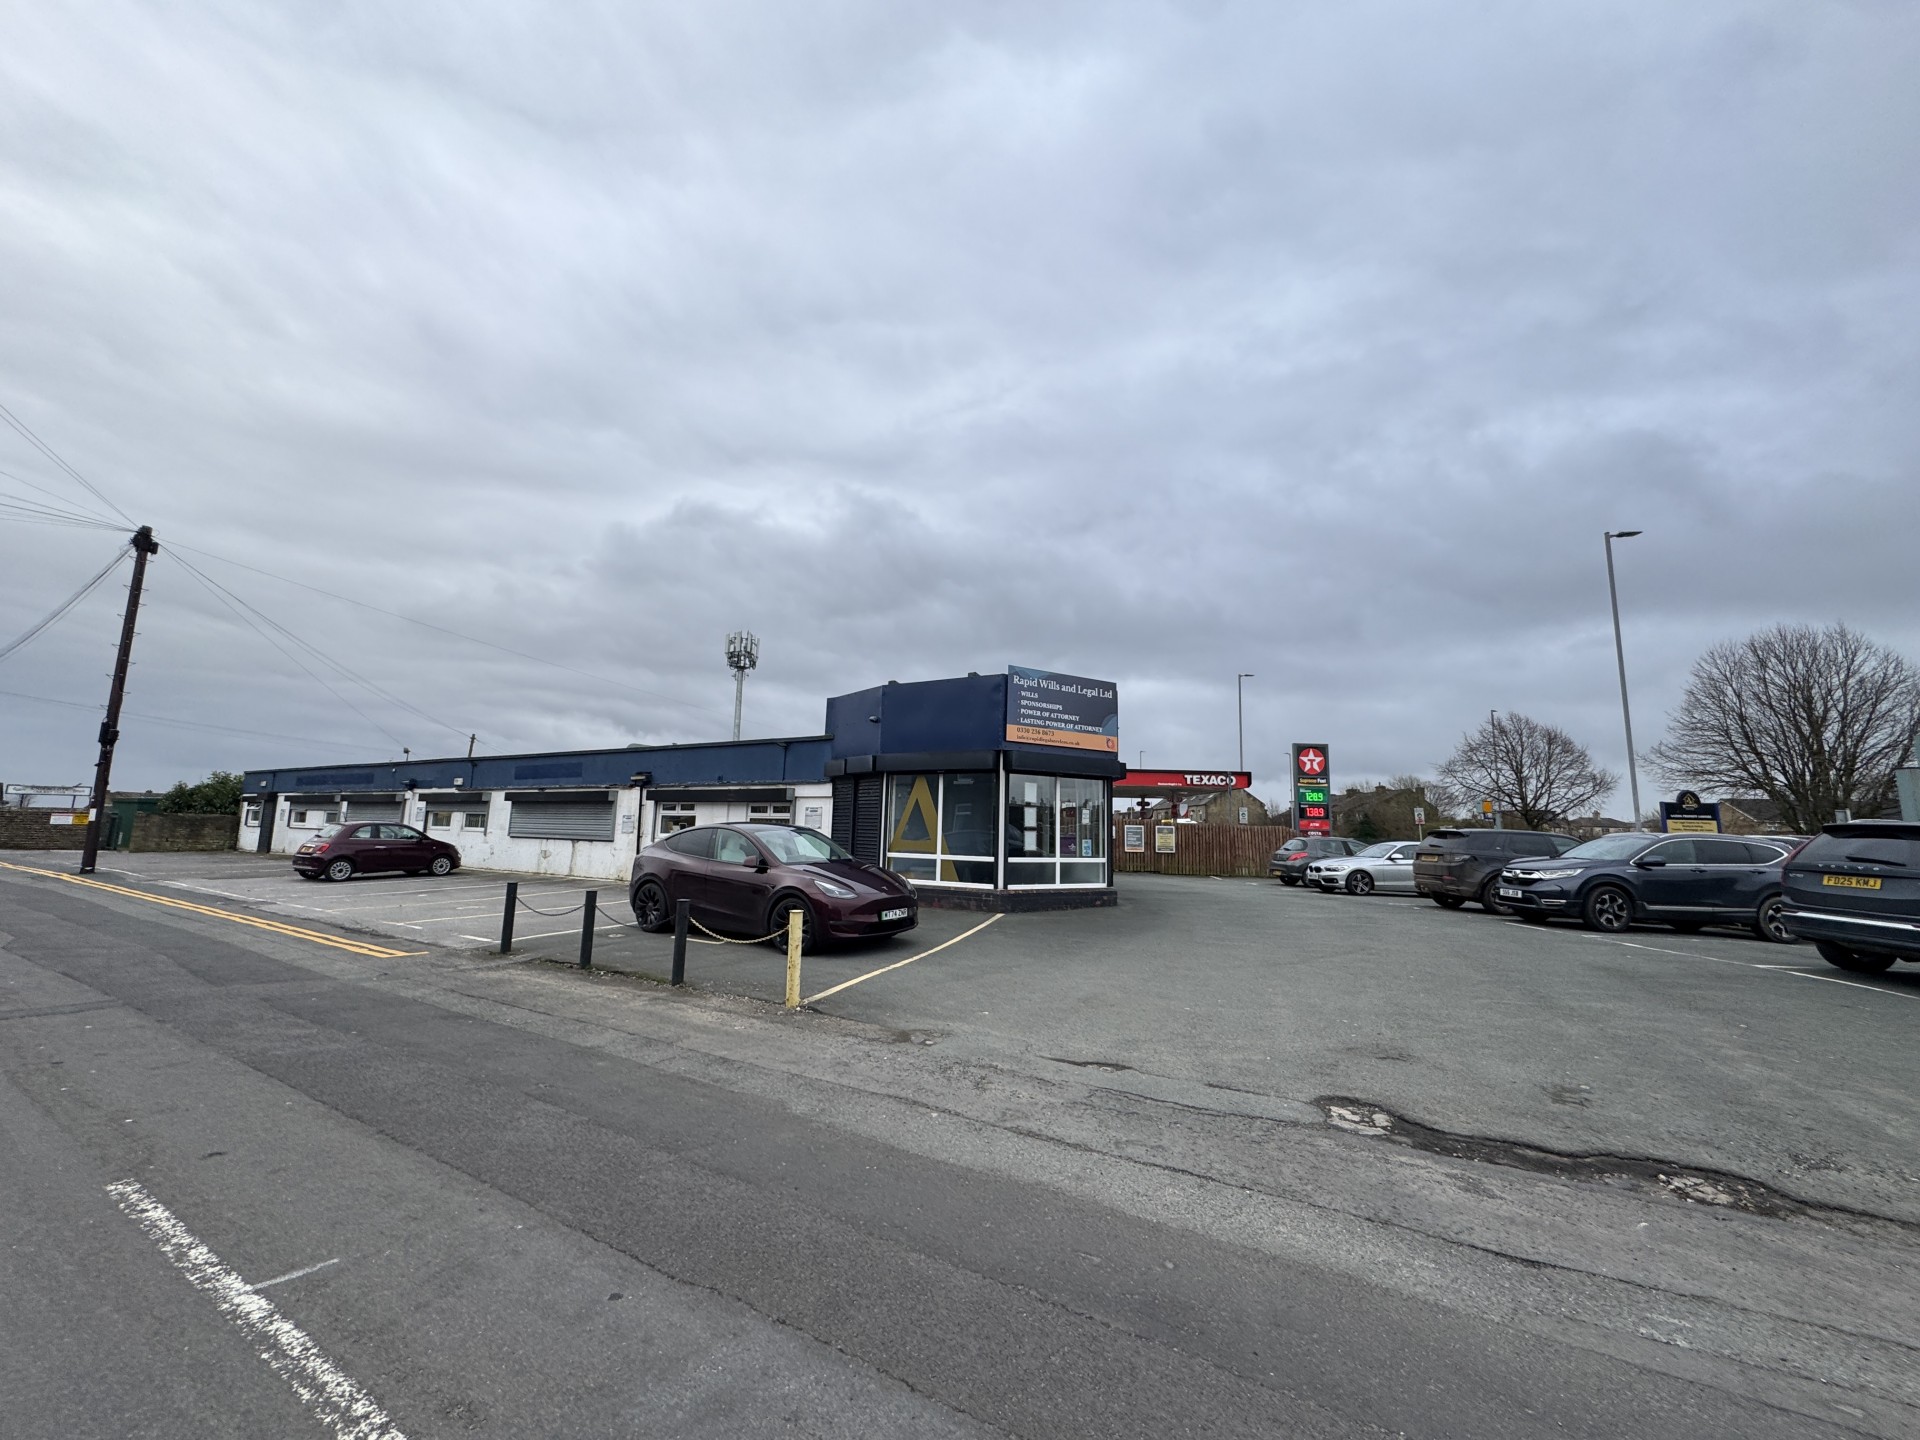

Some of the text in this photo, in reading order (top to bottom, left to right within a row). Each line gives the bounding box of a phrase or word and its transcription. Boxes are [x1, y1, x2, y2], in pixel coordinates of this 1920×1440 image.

[1013, 675, 1112, 698] Rapid Wills and Legal Ltd
[1020, 700, 1062, 710] SPONSORSHIPS
[1050, 713, 1079, 721] ATTORNEY
[1046, 720, 1066, 728] POWER
[1074, 724, 1103, 733] ATTORNEY
[1184, 774, 1236, 786] TEXACO
[1826, 876, 1877, 888] FD25 KMJ
